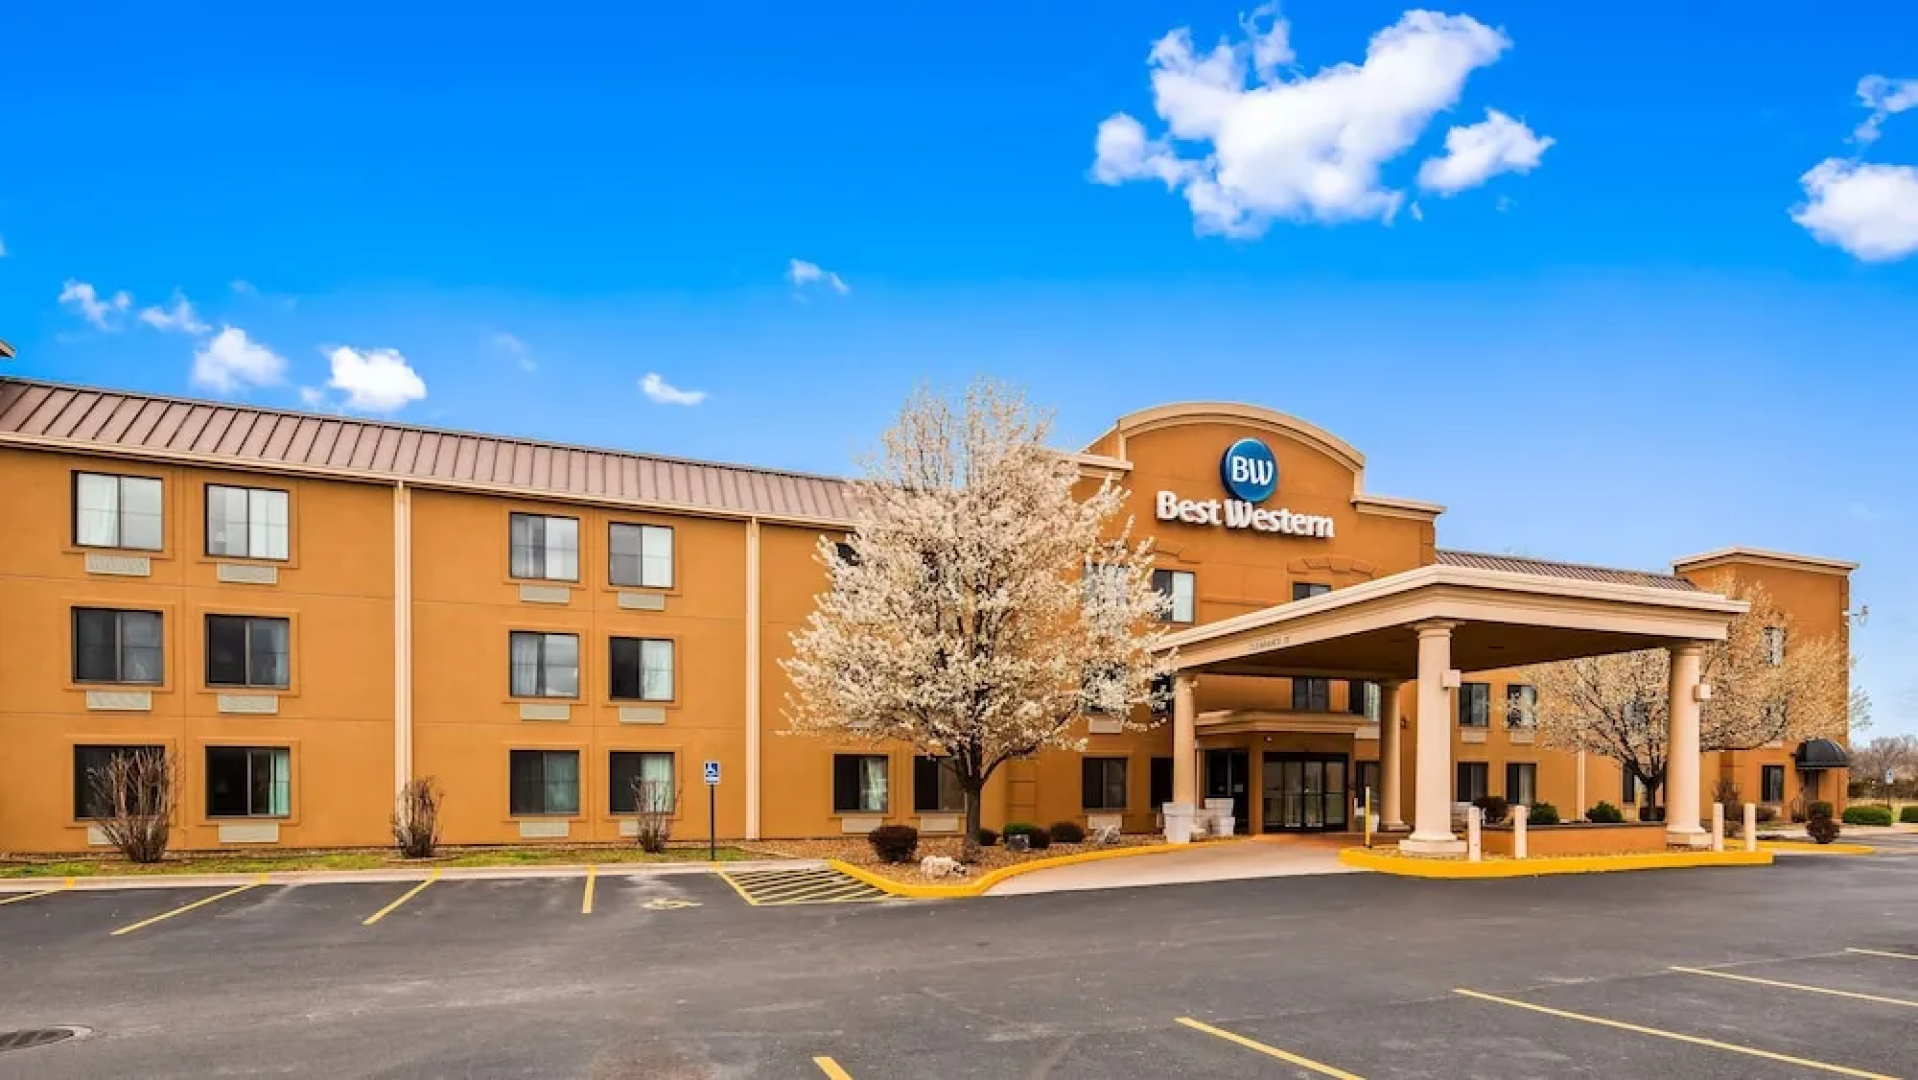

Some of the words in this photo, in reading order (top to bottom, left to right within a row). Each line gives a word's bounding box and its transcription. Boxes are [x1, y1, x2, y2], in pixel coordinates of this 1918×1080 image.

[1232, 456, 1273, 485] BW
[1156, 490, 1222, 525] Best
[1224, 498, 1335, 538] Western
